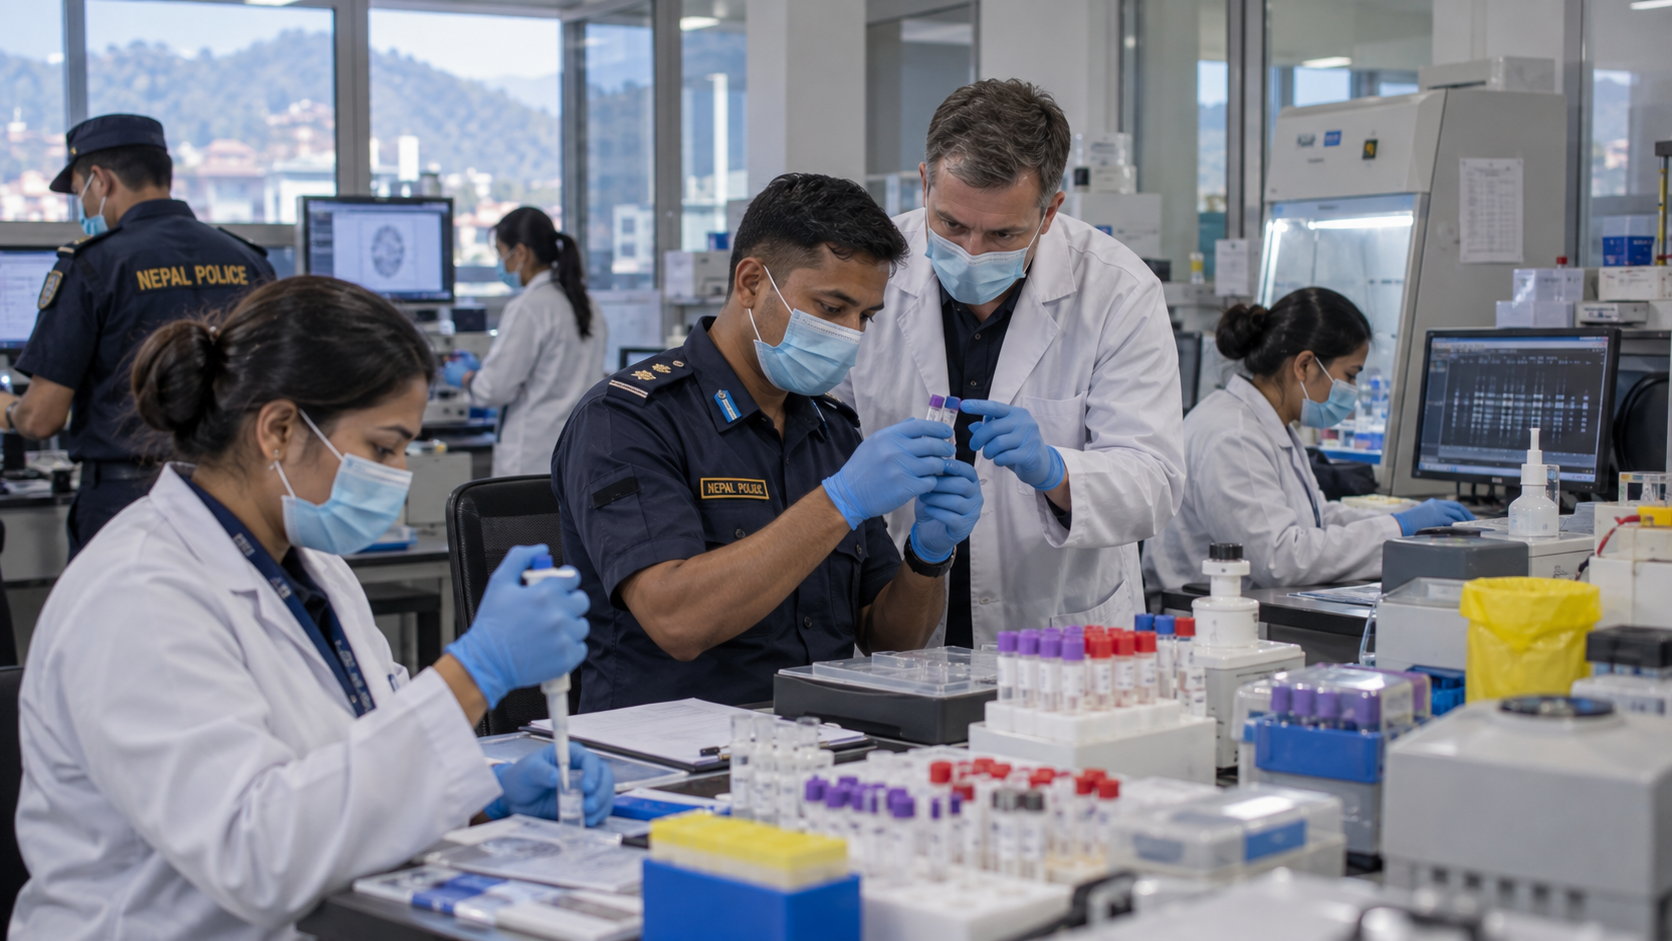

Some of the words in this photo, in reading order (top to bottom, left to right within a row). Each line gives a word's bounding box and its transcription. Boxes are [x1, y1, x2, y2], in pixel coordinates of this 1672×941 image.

[136, 266, 192, 290] NEPAL
[194, 264, 249, 285] POLICE
[707, 482, 736, 494] NEPAL
